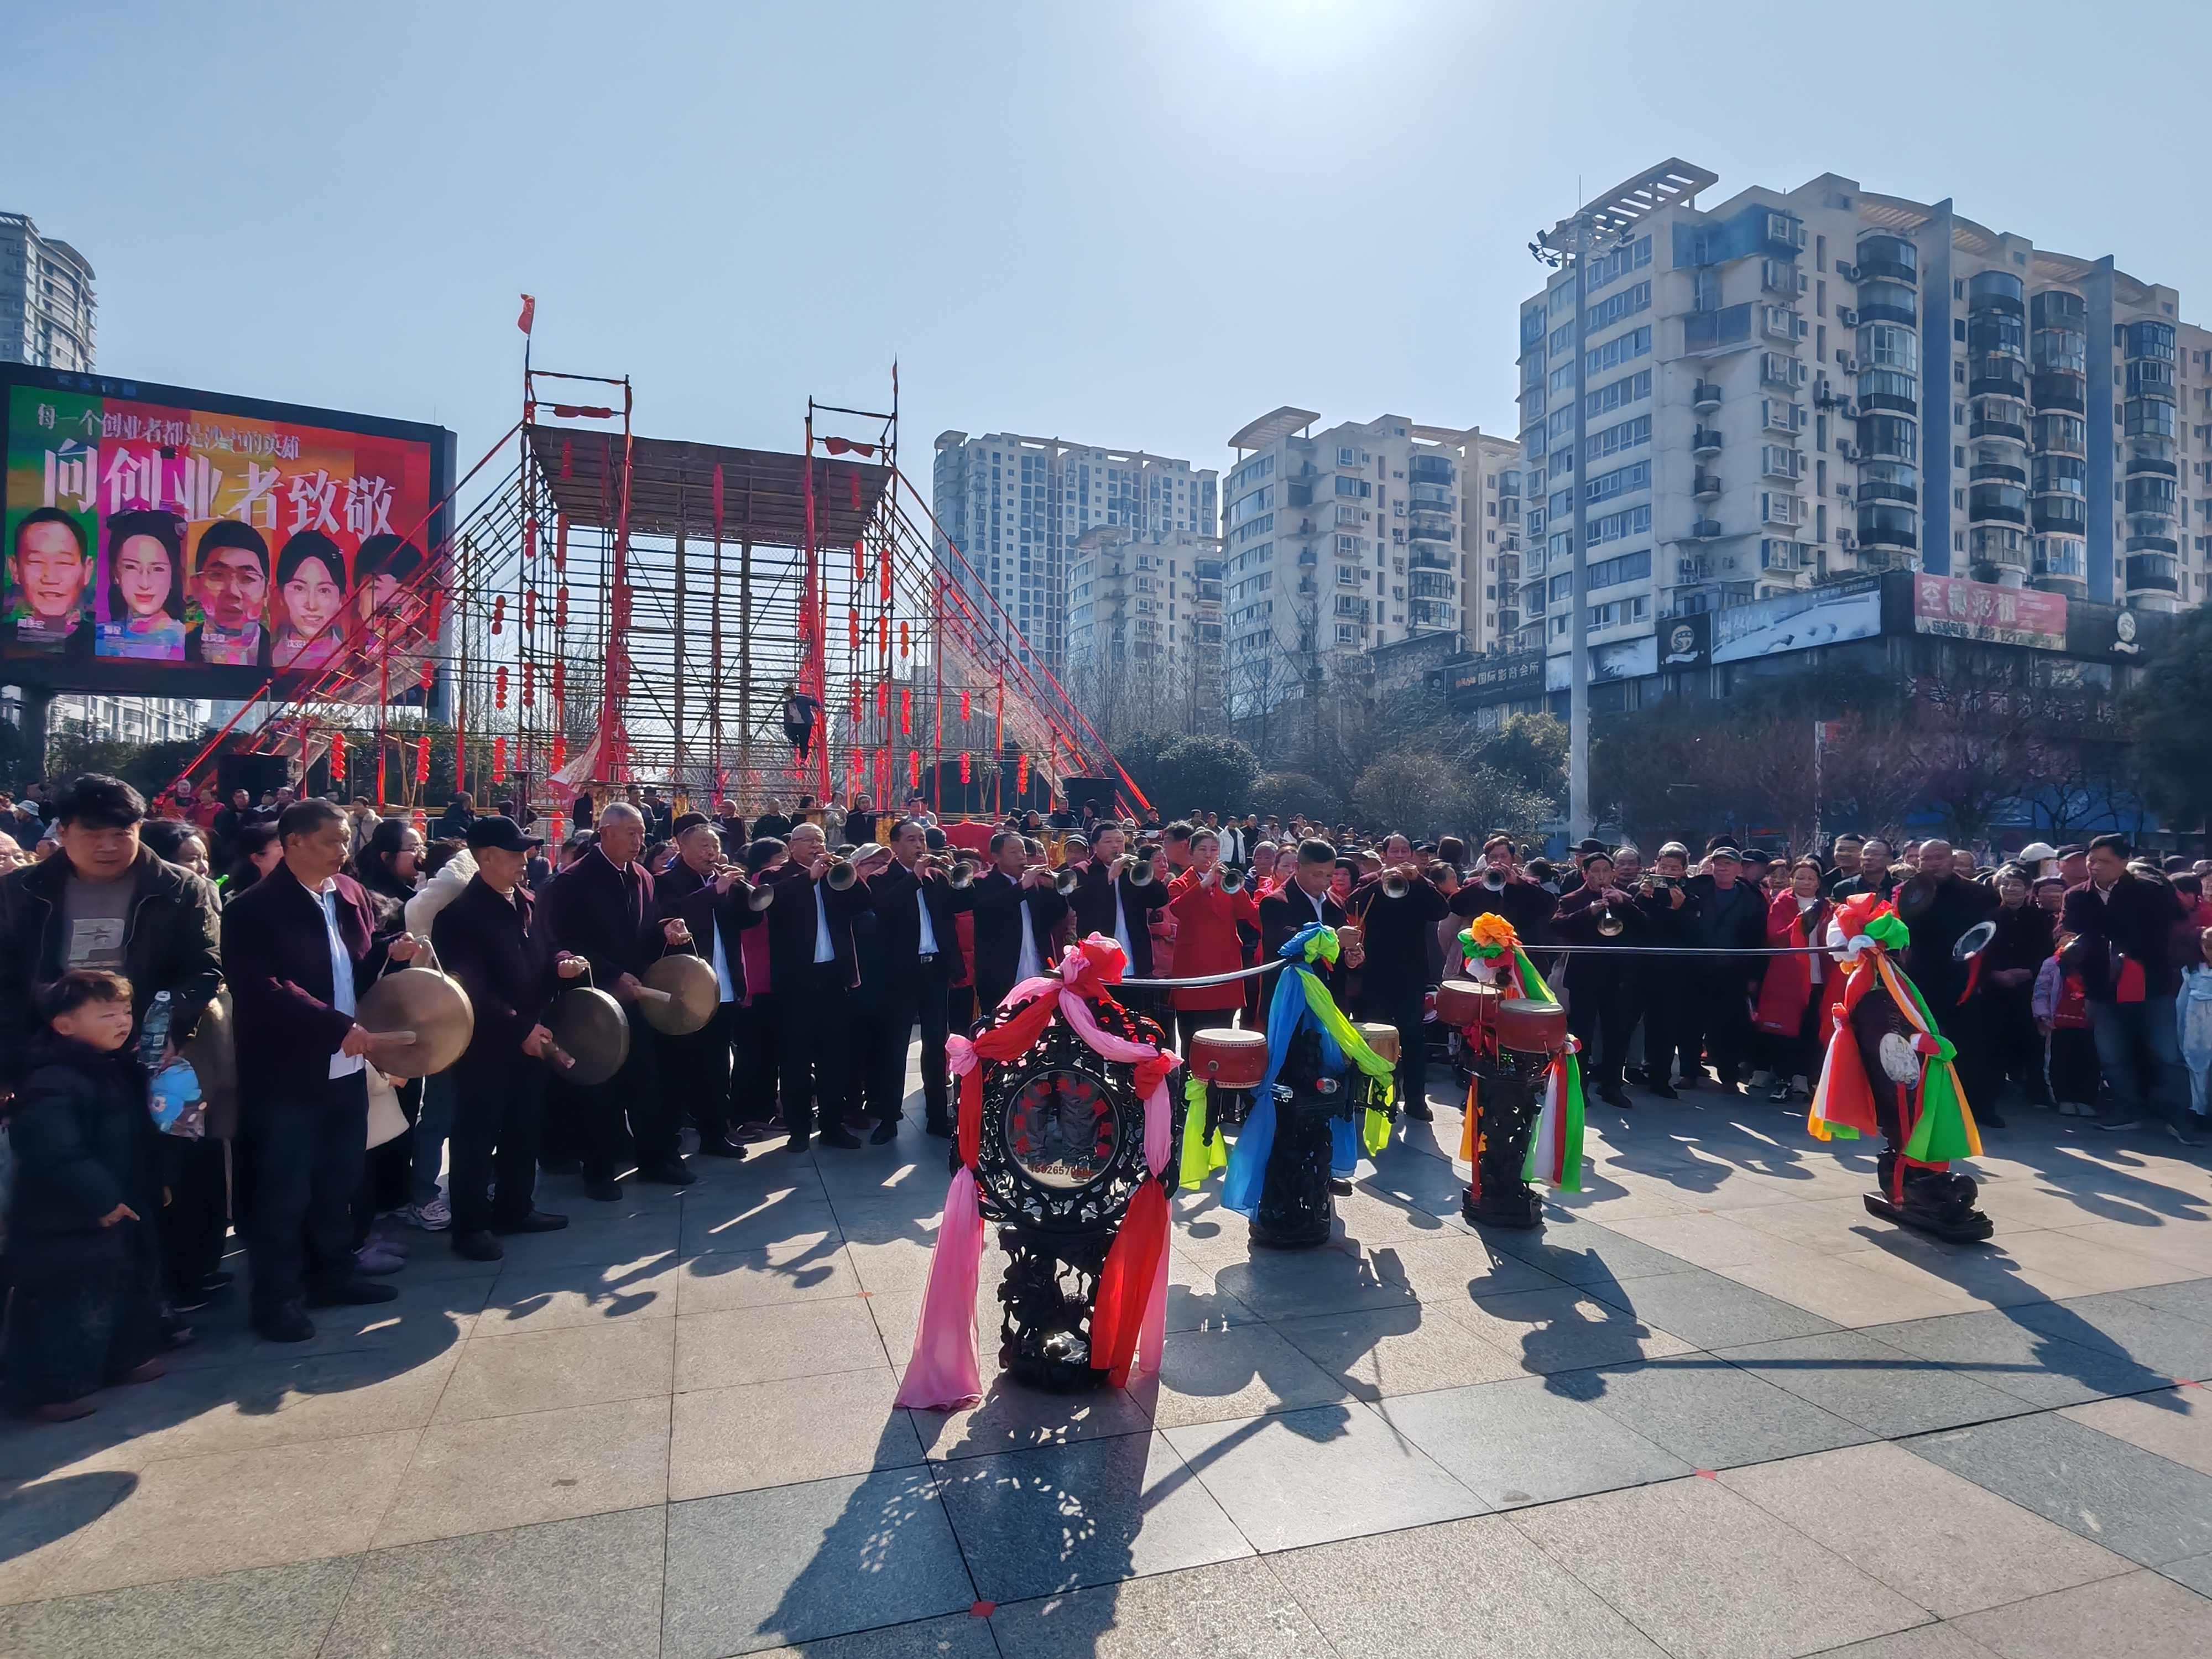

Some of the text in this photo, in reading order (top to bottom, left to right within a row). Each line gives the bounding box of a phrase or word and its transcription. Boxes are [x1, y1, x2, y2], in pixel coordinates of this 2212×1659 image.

[44, 438, 396, 543] 向创业者致敬
